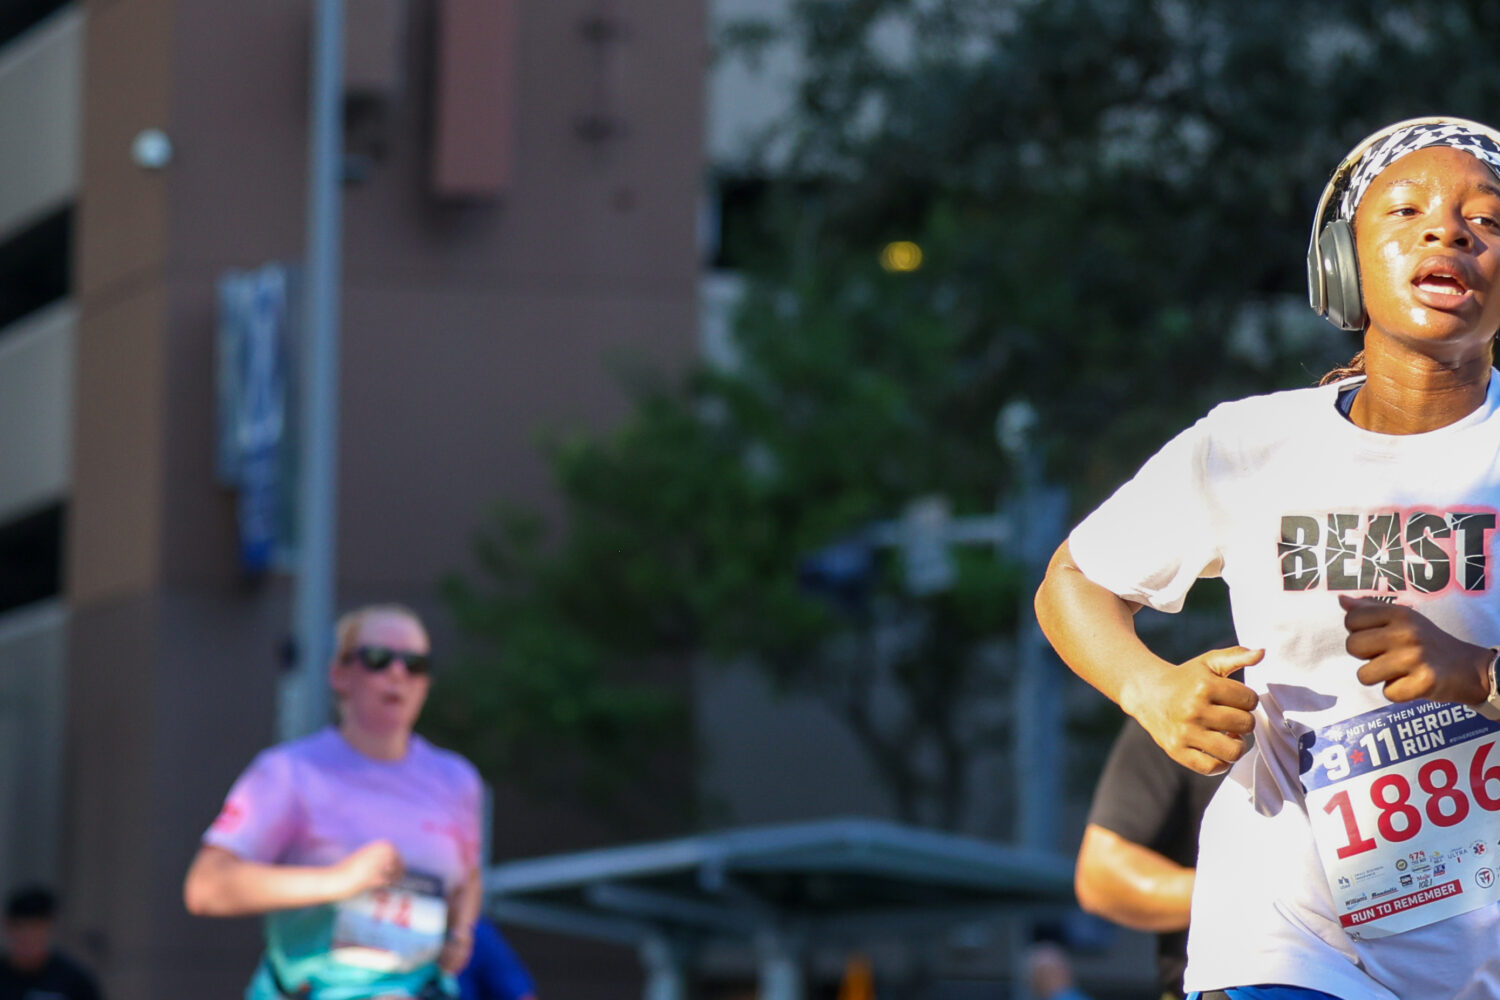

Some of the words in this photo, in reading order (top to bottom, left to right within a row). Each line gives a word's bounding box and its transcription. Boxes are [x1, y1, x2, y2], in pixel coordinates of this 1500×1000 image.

[1277, 511, 1496, 593] BEAST
[1345, 724, 1366, 738] NOT
[1367, 717, 1386, 732] ME,
[1387, 707, 1415, 724] THEN
[1397, 704, 1477, 740] HEROES
[1323, 744, 1350, 781] 9
[1360, 728, 1400, 768] 11
[1402, 730, 1447, 757] RUN
[1351, 908, 1376, 924] RUN
[1376, 904, 1392, 916] TO
[1394, 883, 1457, 911] REMEMBER
